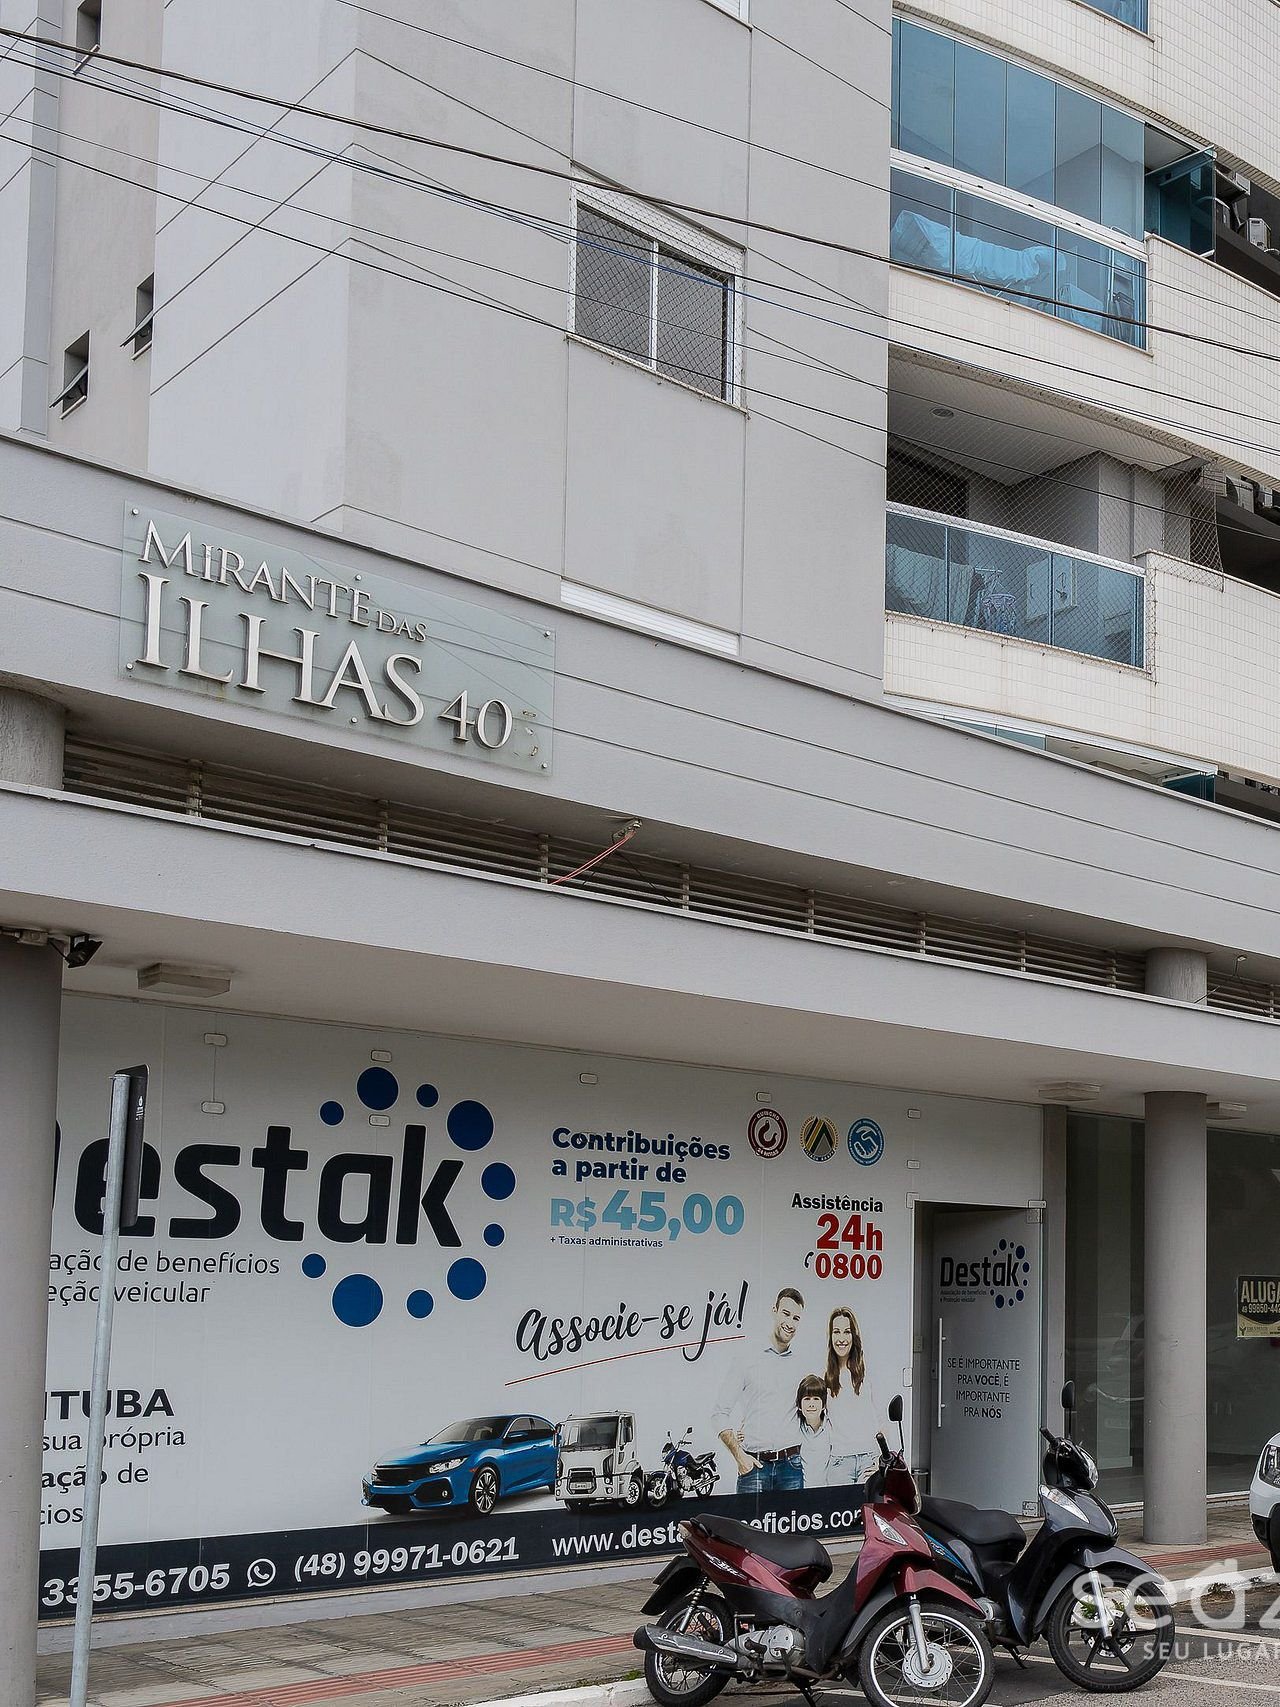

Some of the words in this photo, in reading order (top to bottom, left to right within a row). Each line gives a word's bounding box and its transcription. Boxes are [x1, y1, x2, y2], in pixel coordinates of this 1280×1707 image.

[138, 519, 371, 628] MIRANTE
[376, 609, 427, 642] DAS
[135, 571, 425, 727] ILHAS
[437, 689, 513, 749] 40
[551, 1127, 731, 1162] Contribuições
[551, 1159, 568, 1177] a
[575, 1158, 649, 1183] partir
[655, 1160, 687, 1183] de
[53, 1120, 464, 1247] estak
[791, 1193, 884, 1213] Assistência
[558, 1235, 587, 1246] Taxas
[589, 1236, 663, 1248] administrativas
[816, 1213, 883, 1251] 24h
[116, 1250, 148, 1272] de
[156, 1250, 281, 1274] benefícios
[815, 1252, 883, 1280] 0800
[940, 1253, 1020, 1287] Destak
[114, 1281, 211, 1303] veicular
[682, 1279, 749, 1362] já!
[947, 1357, 956, 1368] SE
[958, 1355, 964, 1369] É
[965, 1358, 1020, 1371] IMPORTANTE
[957, 1374, 973, 1385] PRA
[1003, 1373, 1009, 1387] É
[955, 1390, 1010, 1403] IMPORTANTE
[964, 1406, 979, 1417] PRA
[117, 1462, 149, 1484] de
[294, 1552, 346, 1582] (48)
[353, 1536, 520, 1576] 99971-0621
